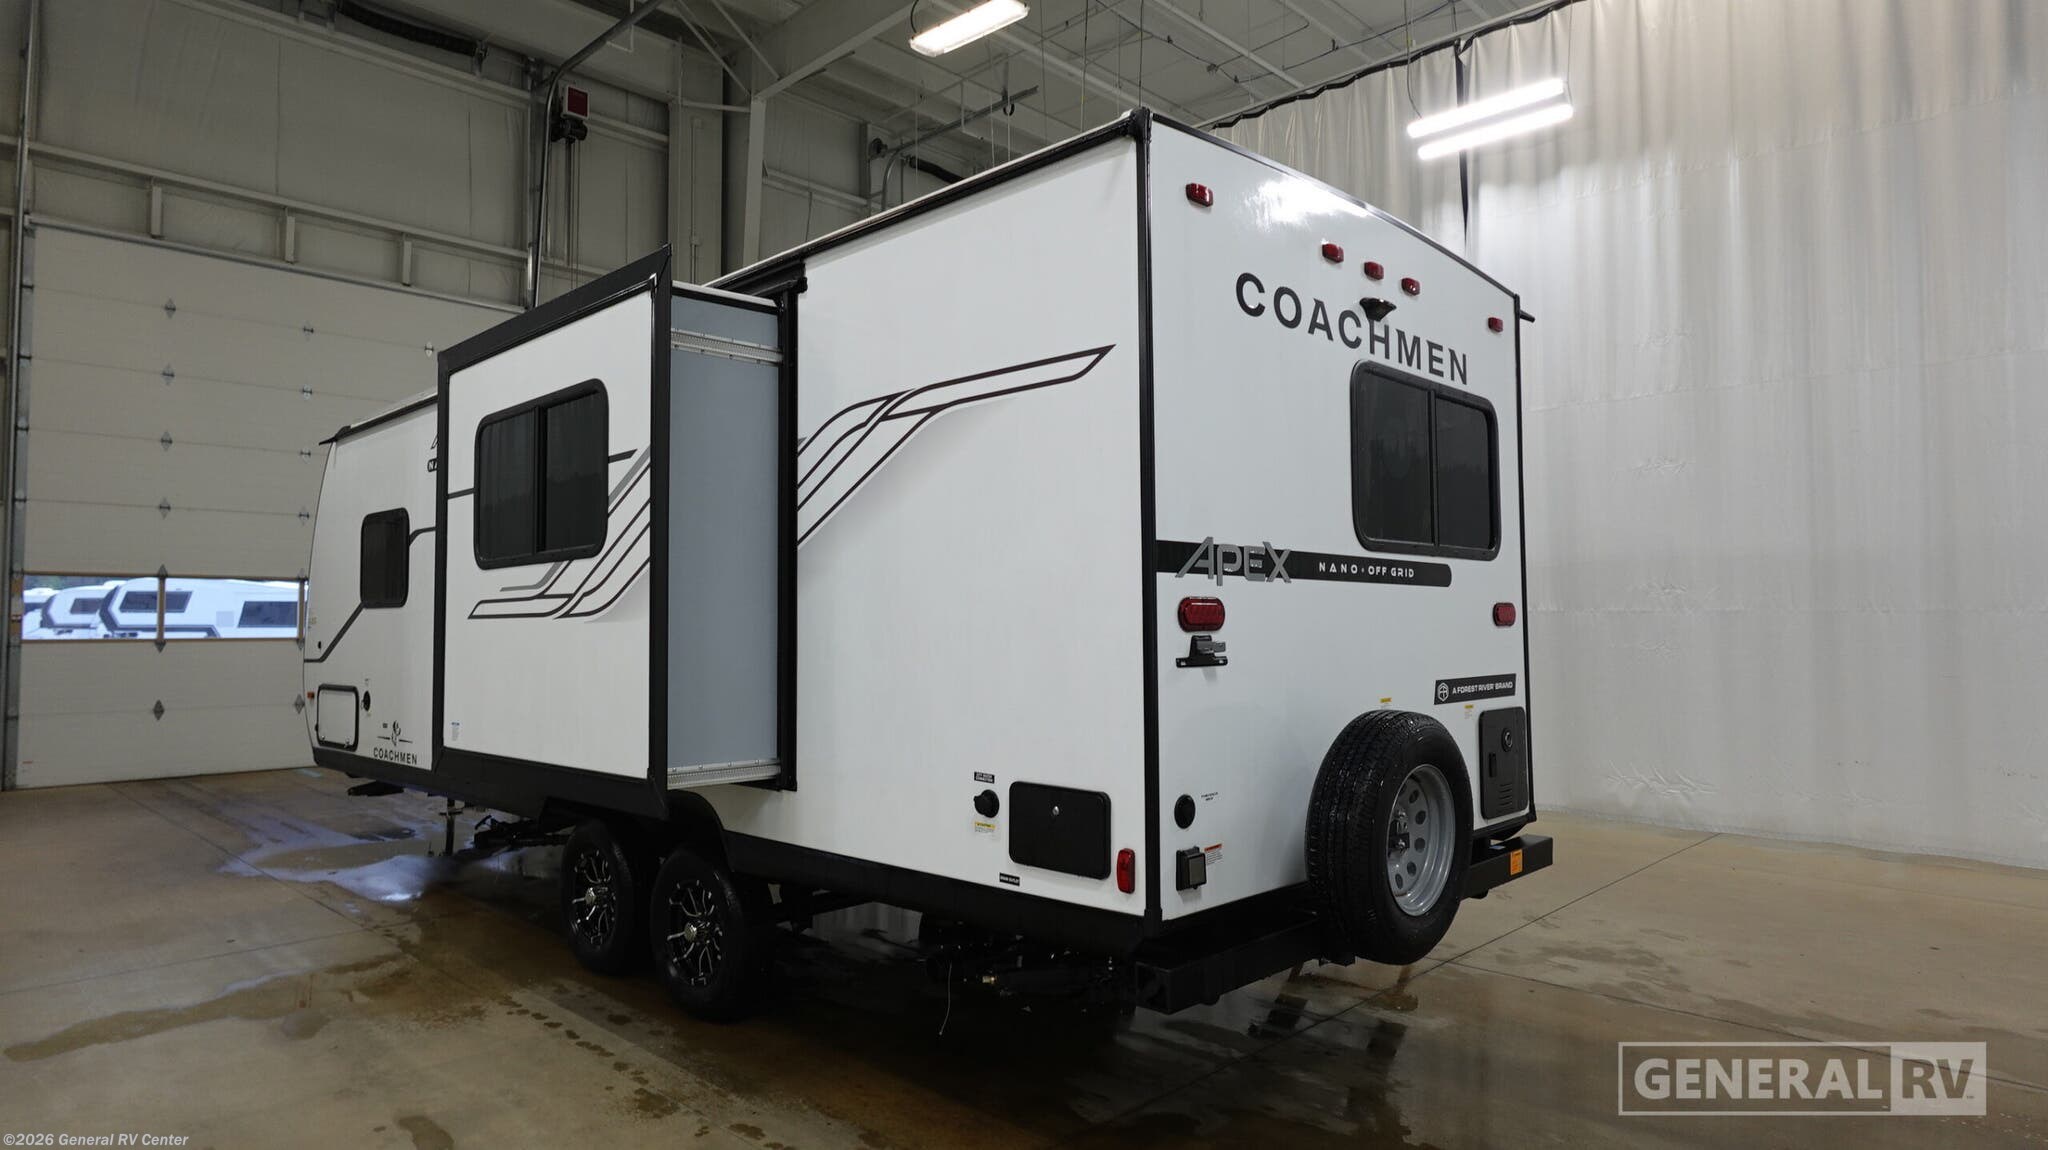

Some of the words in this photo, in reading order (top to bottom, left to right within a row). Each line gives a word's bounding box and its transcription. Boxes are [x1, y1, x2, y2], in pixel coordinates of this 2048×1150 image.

[1235, 272, 1468, 386] COACHMEN
[1174, 536, 1292, 587] APEX
[1318, 562, 1358, 574] NANO
[1367, 565, 1388, 576] OFF
[1390, 567, 1415, 578] GRID
[1457, 685, 1478, 693] FOREST
[1495, 681, 1513, 690] BRAND
[373, 747, 418, 765] COACHMEN
